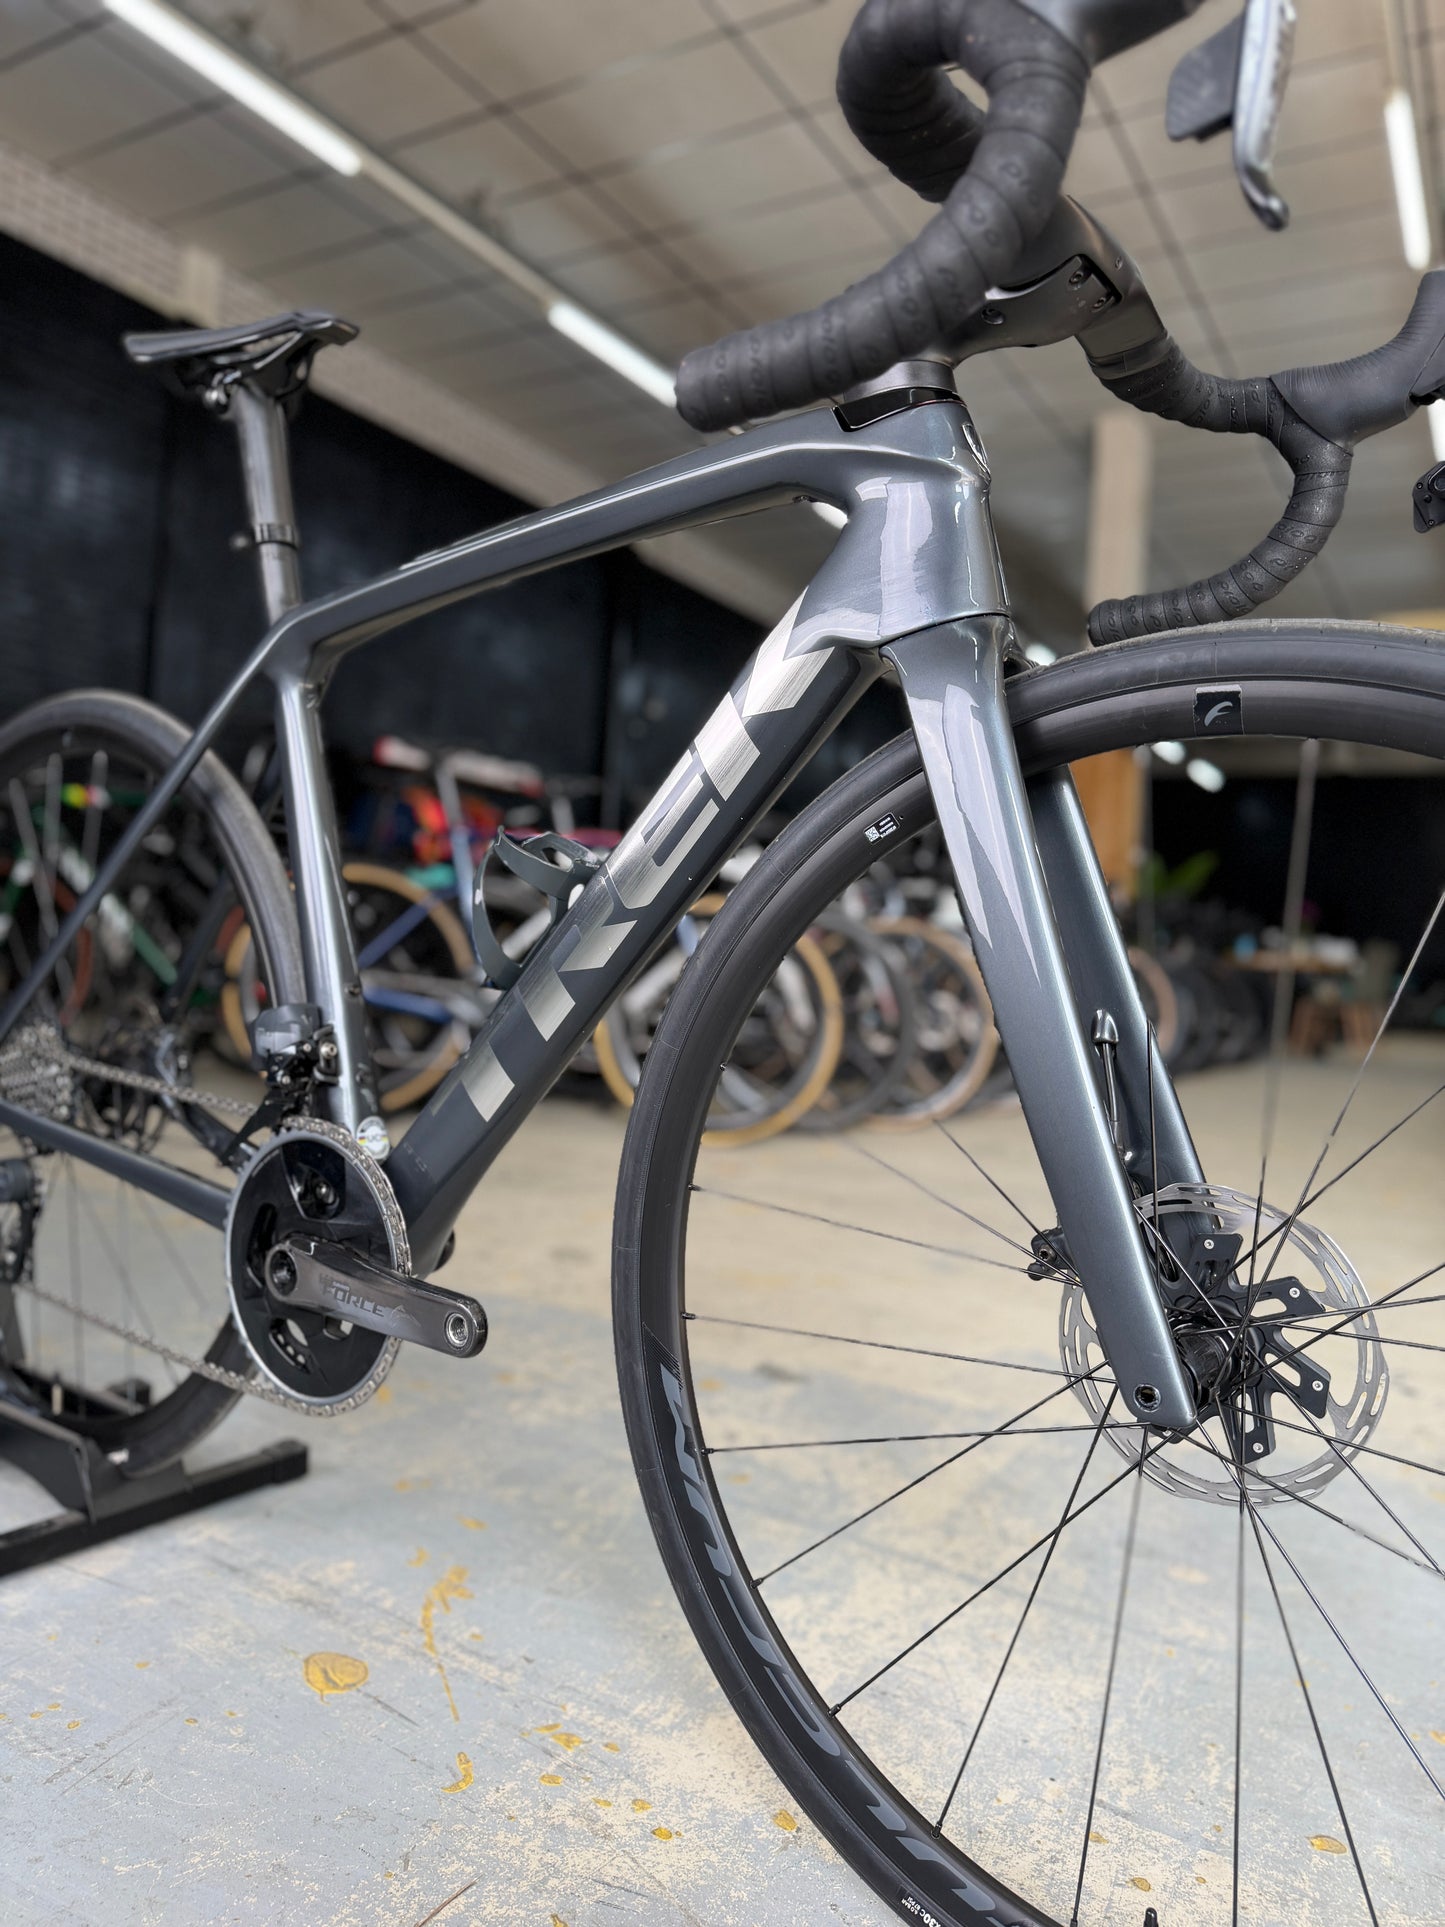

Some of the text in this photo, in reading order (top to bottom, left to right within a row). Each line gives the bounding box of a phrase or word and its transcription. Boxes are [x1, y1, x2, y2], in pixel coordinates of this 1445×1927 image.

[432, 586, 836, 1122] TREK
[319, 1274, 385, 1318] FORCE
[659, 1362, 1005, 1927] ULCRUM
